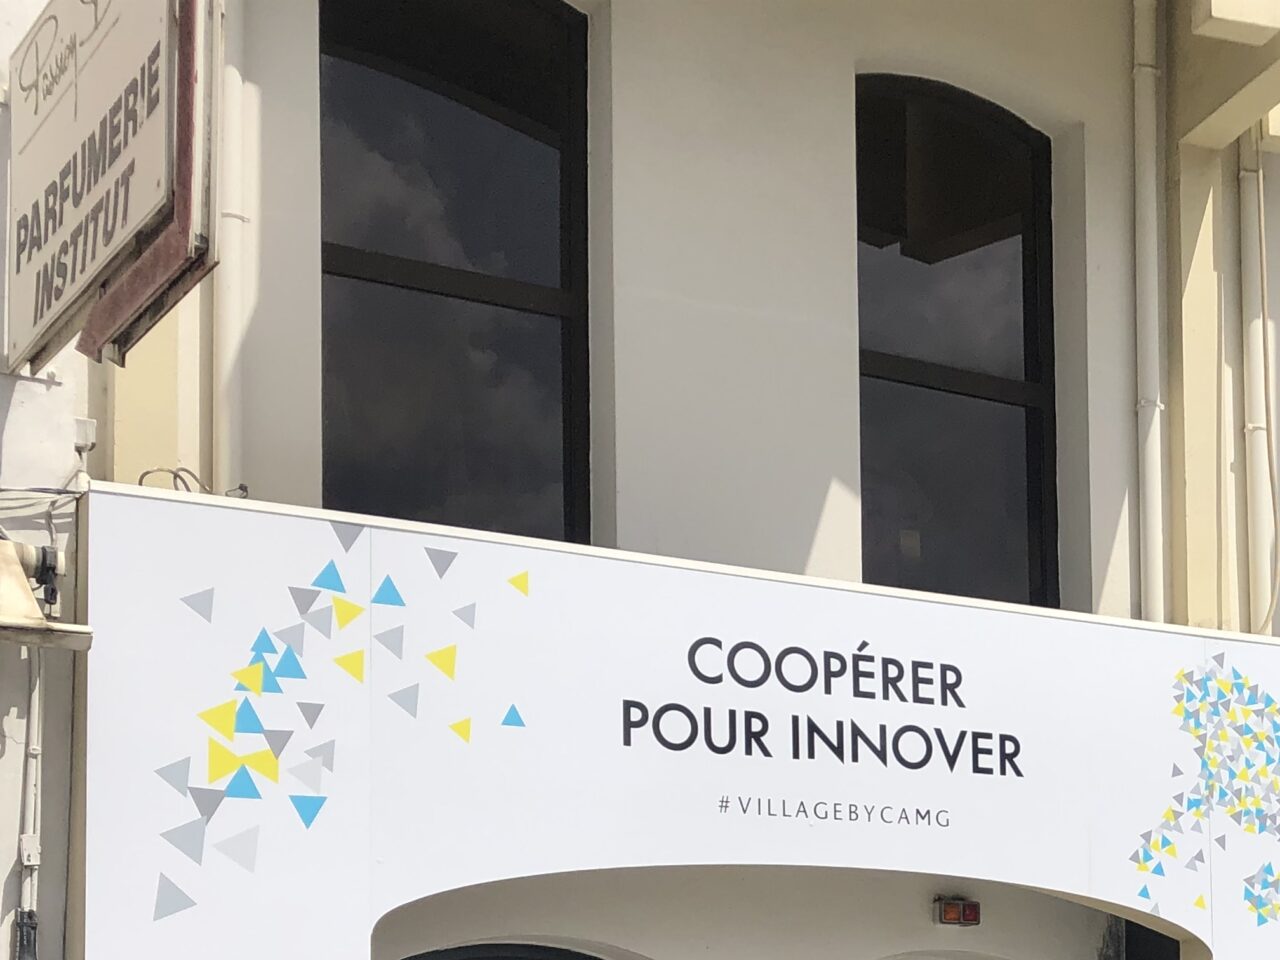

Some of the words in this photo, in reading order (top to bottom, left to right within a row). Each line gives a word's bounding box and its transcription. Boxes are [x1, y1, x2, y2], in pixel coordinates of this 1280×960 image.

[15, 39, 161, 275] PARFUMERIE
[32, 157, 136, 329] INSTITUT
[687, 636, 966, 708] COOPÉRER
[622, 699, 773, 759] POUR
[791, 714, 1025, 778] INNOVER
[718, 795, 952, 828] #VILLAGEBYCAMG
